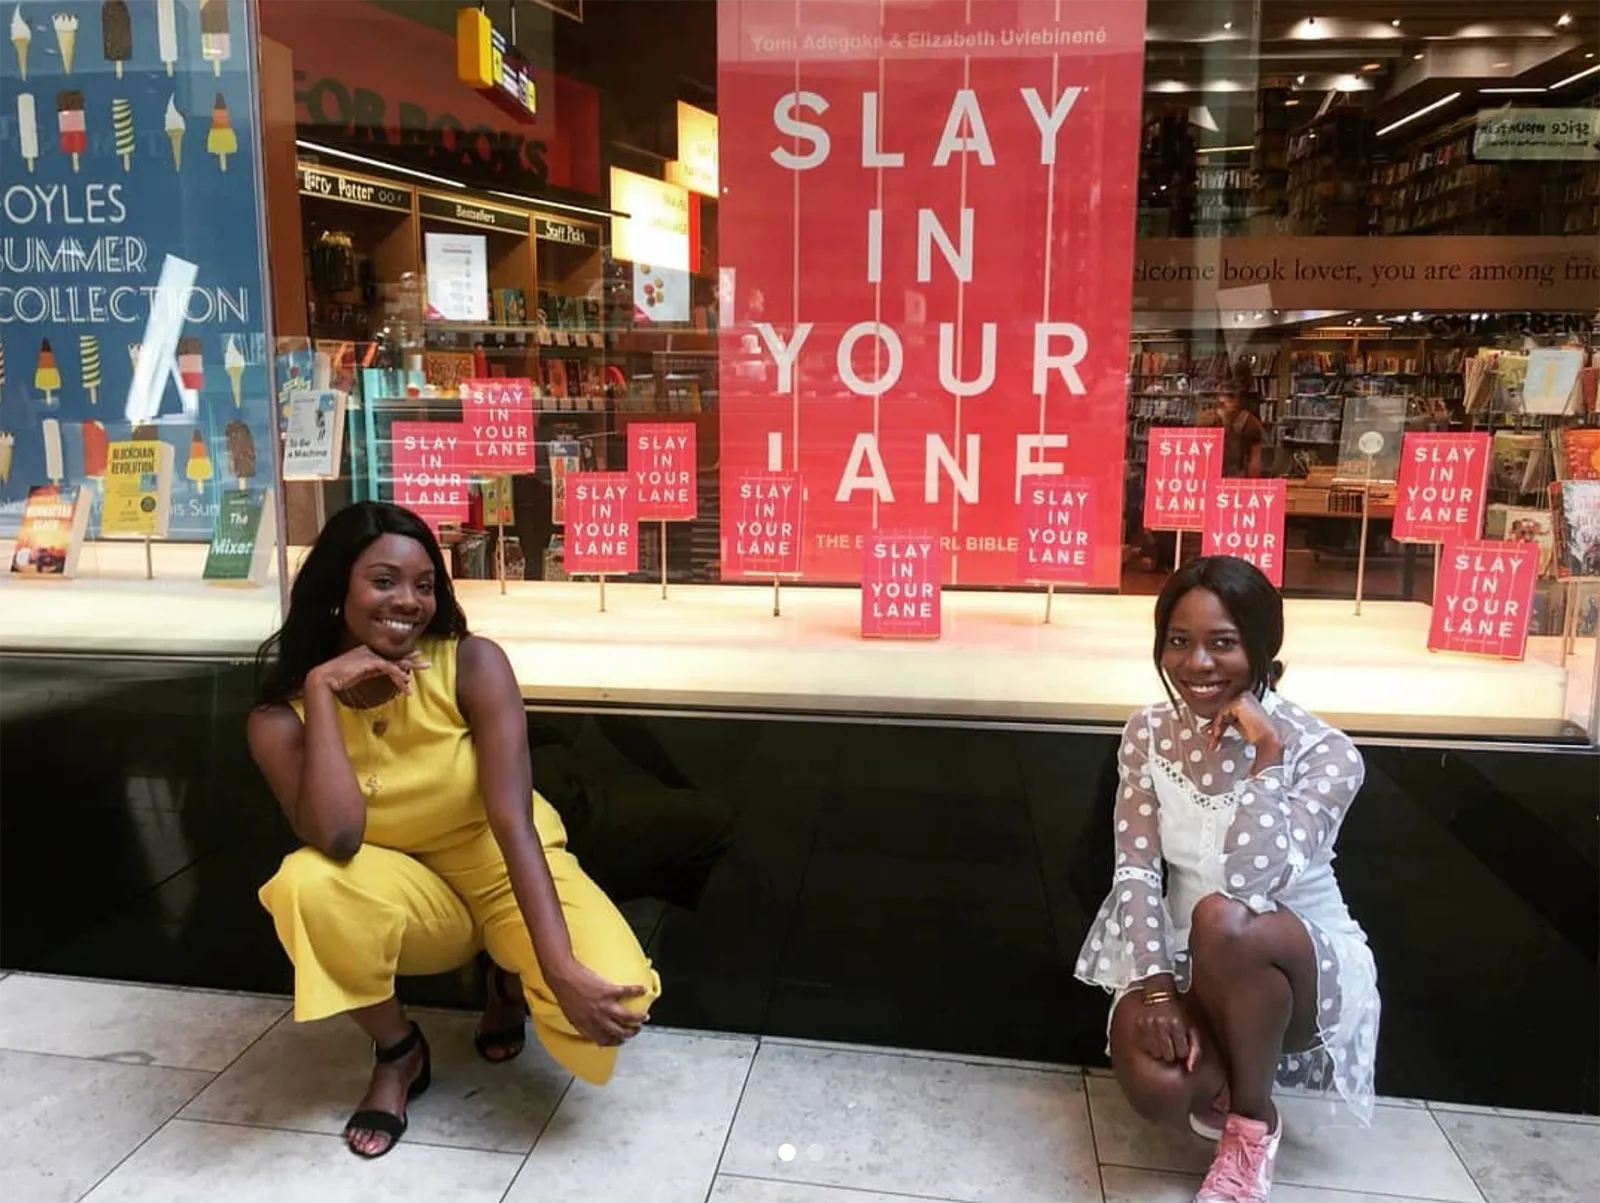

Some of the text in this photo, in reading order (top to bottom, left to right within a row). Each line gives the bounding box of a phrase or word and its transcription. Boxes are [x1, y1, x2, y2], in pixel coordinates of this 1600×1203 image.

[752, 33, 797, 53] Yomi
[803, 32, 883, 54] Adegoke
[889, 32, 903, 49] &
[908, 30, 995, 48] Elizabeth
[770, 86, 1083, 170] SLAY
[303, 169, 374, 201] Harry Potter
[0, 184, 127, 225] OYLES
[455, 204, 496, 225] Bestsellers
[545, 221, 566, 242] Staff
[868, 208, 974, 283] IN
[0, 236, 148, 273] UMMER
[1223, 258, 1286, 281] book
[1294, 258, 1362, 285] lover,
[1371, 263, 1416, 288] you
[1424, 263, 1461, 281] are
[1469, 263, 1554, 288] among
[0, 285, 249, 324] COLLECTON
[758, 320, 1089, 397] YOUR
[473, 390, 523, 405] SLAY
[489, 408, 509, 422] IN
[473, 426, 528, 440] YOUR
[403, 436, 458, 452] SLAY
[475, 442, 528, 457] LANE
[638, 436, 688, 451] SLAY
[1159, 440, 1214, 456] SLAY
[112, 447, 155, 460] BLOCKCHAIN
[420, 454, 442, 469] IN
[653, 453, 672, 468] IN
[1414, 446, 1476, 463] SLAY
[111, 461, 155, 475] REVOLUTION
[1174, 459, 1196, 475] IN
[1430, 465, 1454, 481] IN
[402, 473, 462, 487] YOUR
[636, 471, 690, 485] YOUR
[405, 491, 461, 506] LANE
[575, 485, 629, 501] SLAY
[638, 488, 689, 503] LANE
[740, 483, 793, 500] SLAY
[1033, 489, 1088, 507] SLAY
[1407, 485, 1473, 503] YOUR
[1215, 492, 1275, 509] SLAY
[591, 503, 612, 519] IN
[755, 502, 775, 517] IN
[1048, 509, 1070, 525] IN
[1405, 506, 1469, 523] LANE
[229, 512, 249, 525] The
[1233, 512, 1256, 529] IN
[573, 522, 629, 537] YOUR
[736, 521, 793, 537] YOUR
[1028, 527, 1089, 546] YOUR
[211, 538, 253, 556] Mixer
[574, 541, 628, 556] LANE
[737, 540, 791, 556] LANE
[815, 534, 850, 549] THE
[938, 536, 962, 551] RL
[966, 536, 1020, 552] BIBLE
[1212, 532, 1276, 549] YOUR
[874, 543, 931, 559] SLAY
[1028, 548, 1086, 566] LANE
[1213, 552, 1274, 568] NE
[1454, 554, 1524, 574] SLAY
[891, 562, 914, 578] IN
[871, 582, 935, 598] YOUR
[1472, 576, 1498, 594] IN
[872, 602, 933, 619] LANE
[1445, 595, 1519, 615] YOUR
[1443, 616, 1514, 638] LANE
